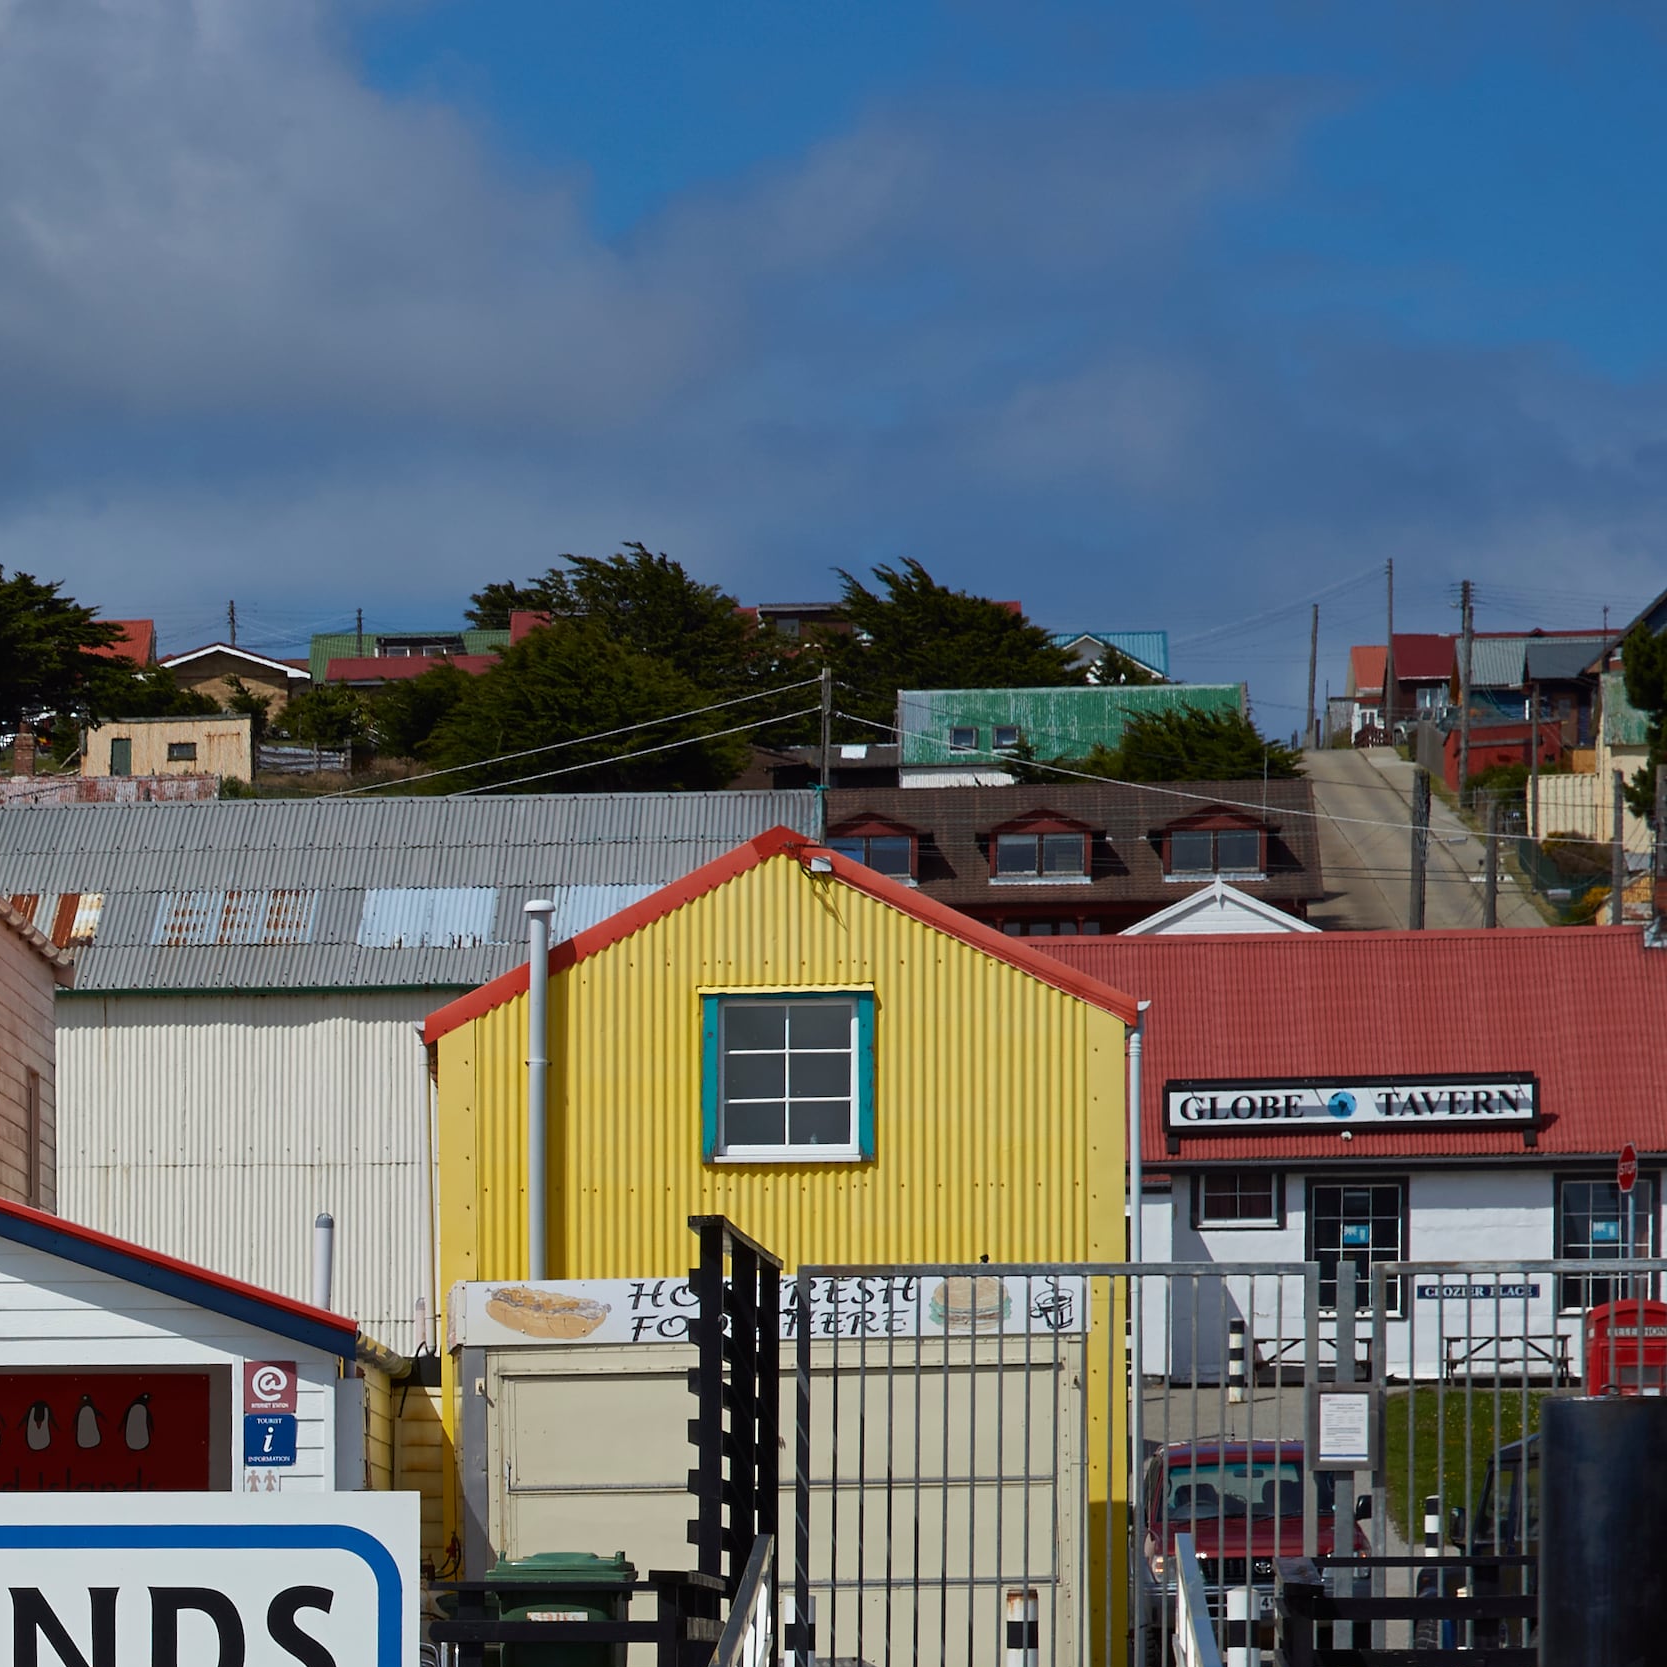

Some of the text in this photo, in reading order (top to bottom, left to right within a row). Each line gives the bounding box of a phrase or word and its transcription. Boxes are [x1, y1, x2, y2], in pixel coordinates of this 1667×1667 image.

[1180, 1089, 1522, 1121] GLOBE TAVERN
[779, 1277, 917, 1306] RESH
